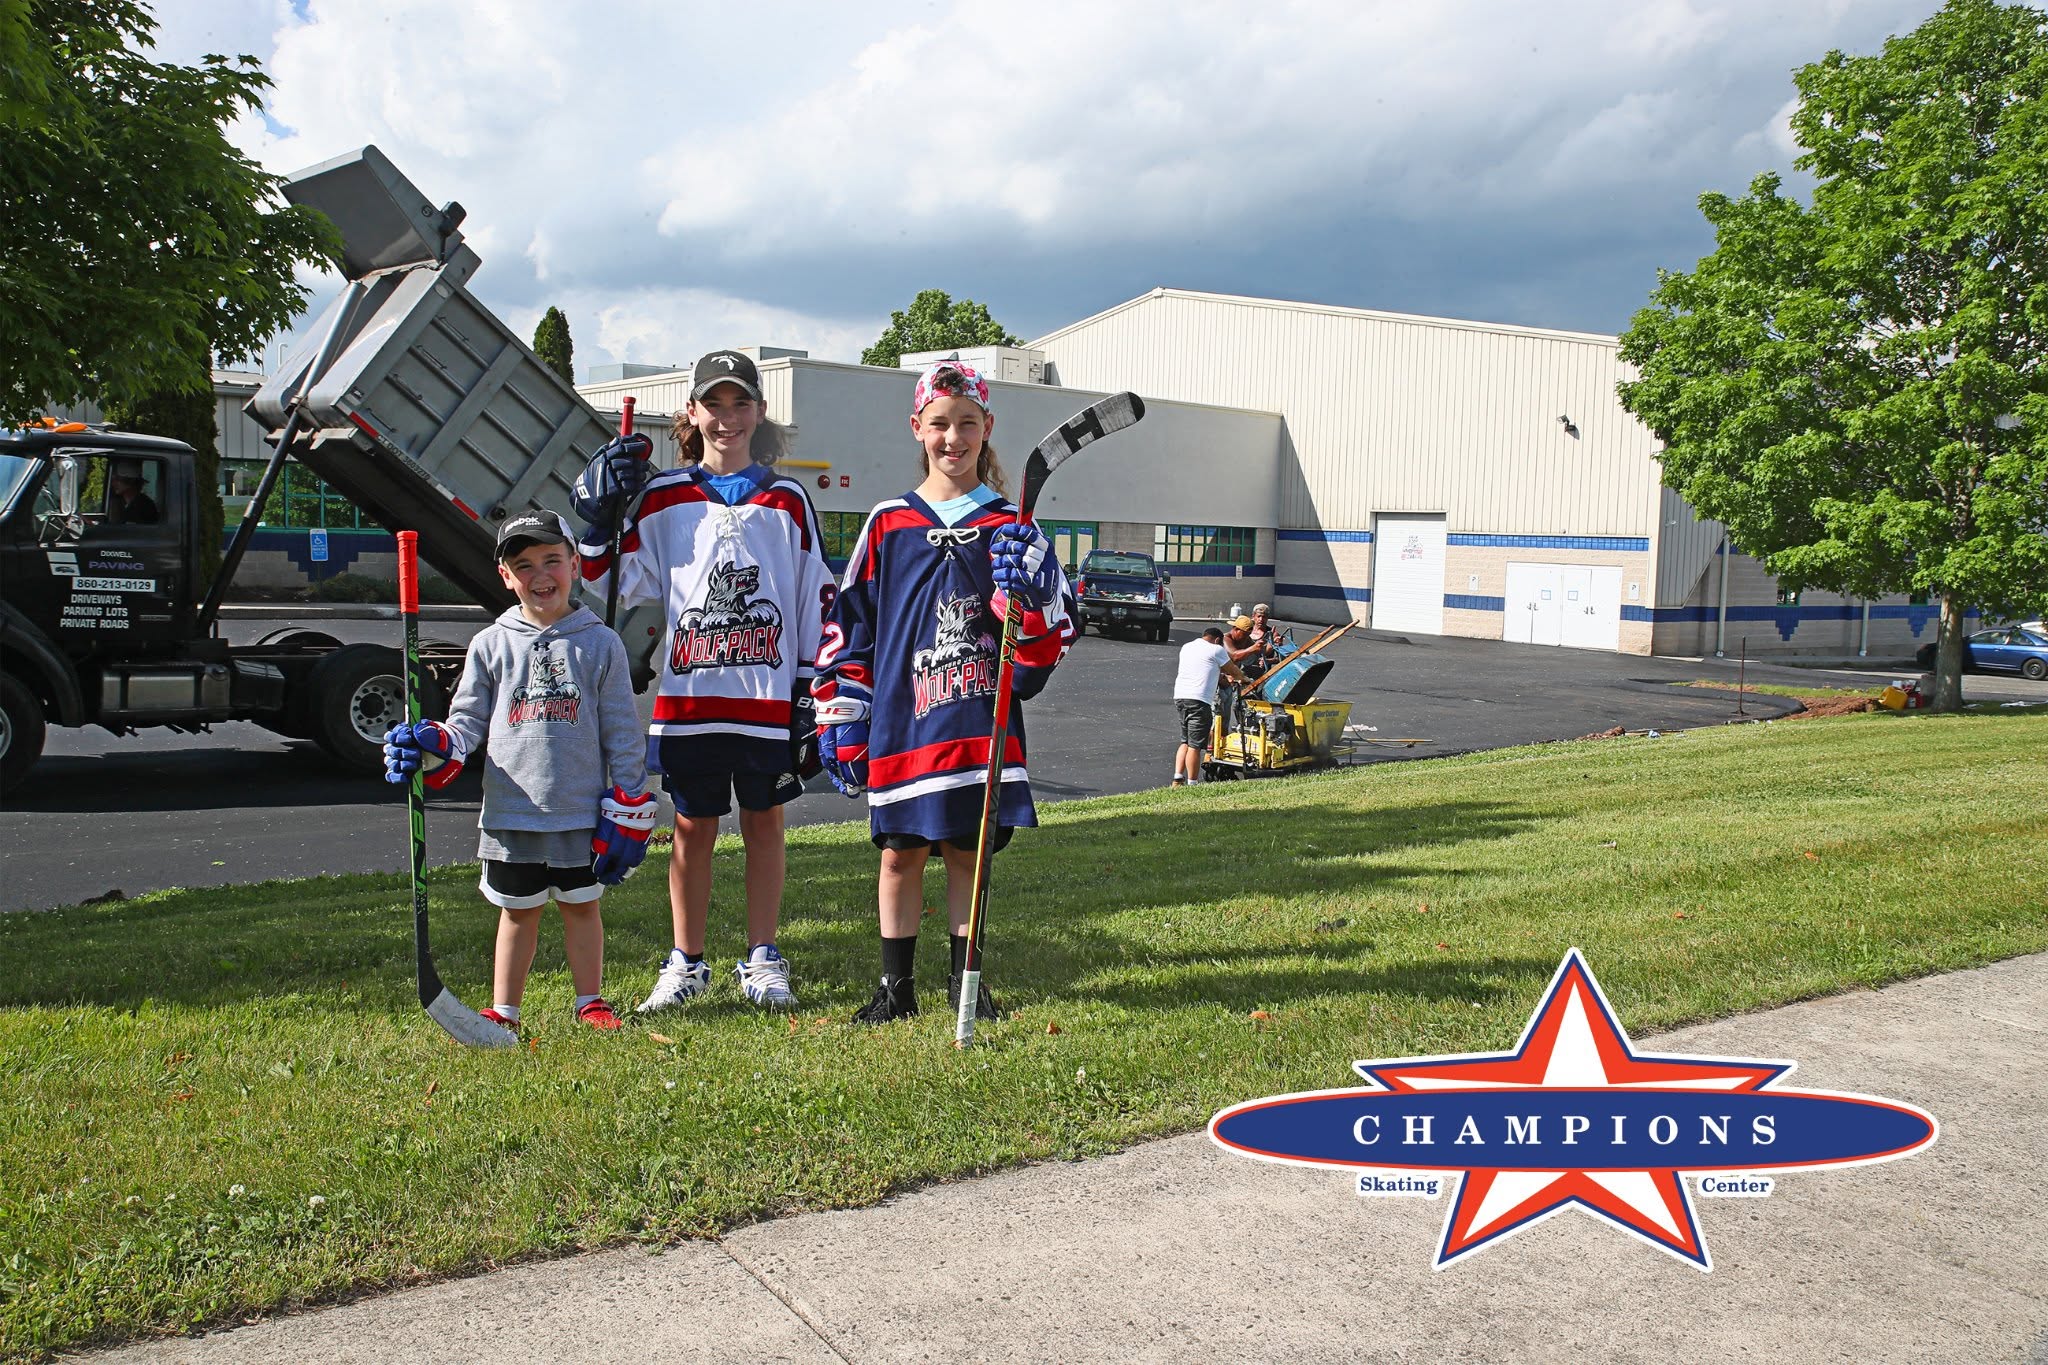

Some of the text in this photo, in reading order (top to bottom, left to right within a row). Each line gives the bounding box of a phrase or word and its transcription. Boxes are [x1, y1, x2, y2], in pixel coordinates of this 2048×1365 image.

[100, 550, 133, 558] DIXWELL
[88, 561, 145, 570] PAVING
[77, 580, 151, 590] 860-213-0129
[71, 594, 122, 604] DRIVEWAYS
[63, 606, 128, 616] PARKING LOTS
[60, 618, 129, 629] PRIVATE ROADS
[725, 626, 780, 662] PACK
[961, 658, 999, 696] PAC
[544, 698, 580, 721] PACK
